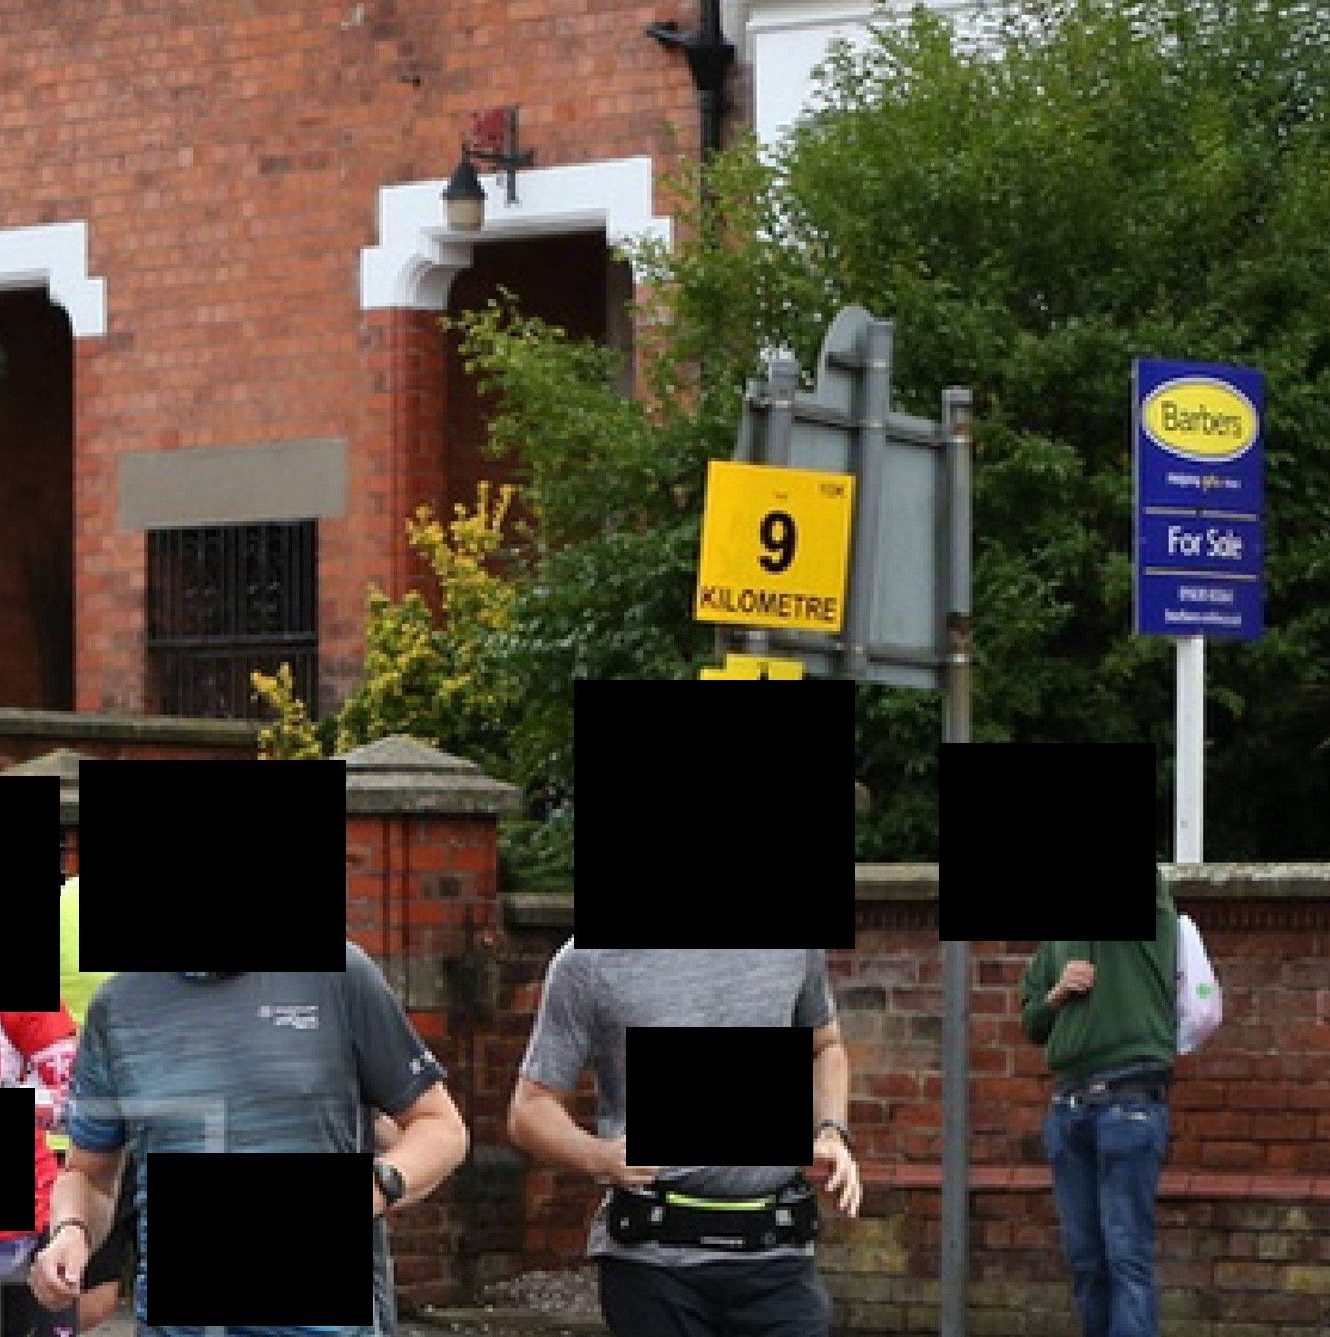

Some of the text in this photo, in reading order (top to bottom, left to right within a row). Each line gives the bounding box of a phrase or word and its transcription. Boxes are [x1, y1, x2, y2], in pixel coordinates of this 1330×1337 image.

[1160, 400, 1242, 439] Barbers
[759, 509, 798, 575] 9
[1167, 525, 1242, 560] For Sale
[700, 585, 837, 623] KILOMETRE
